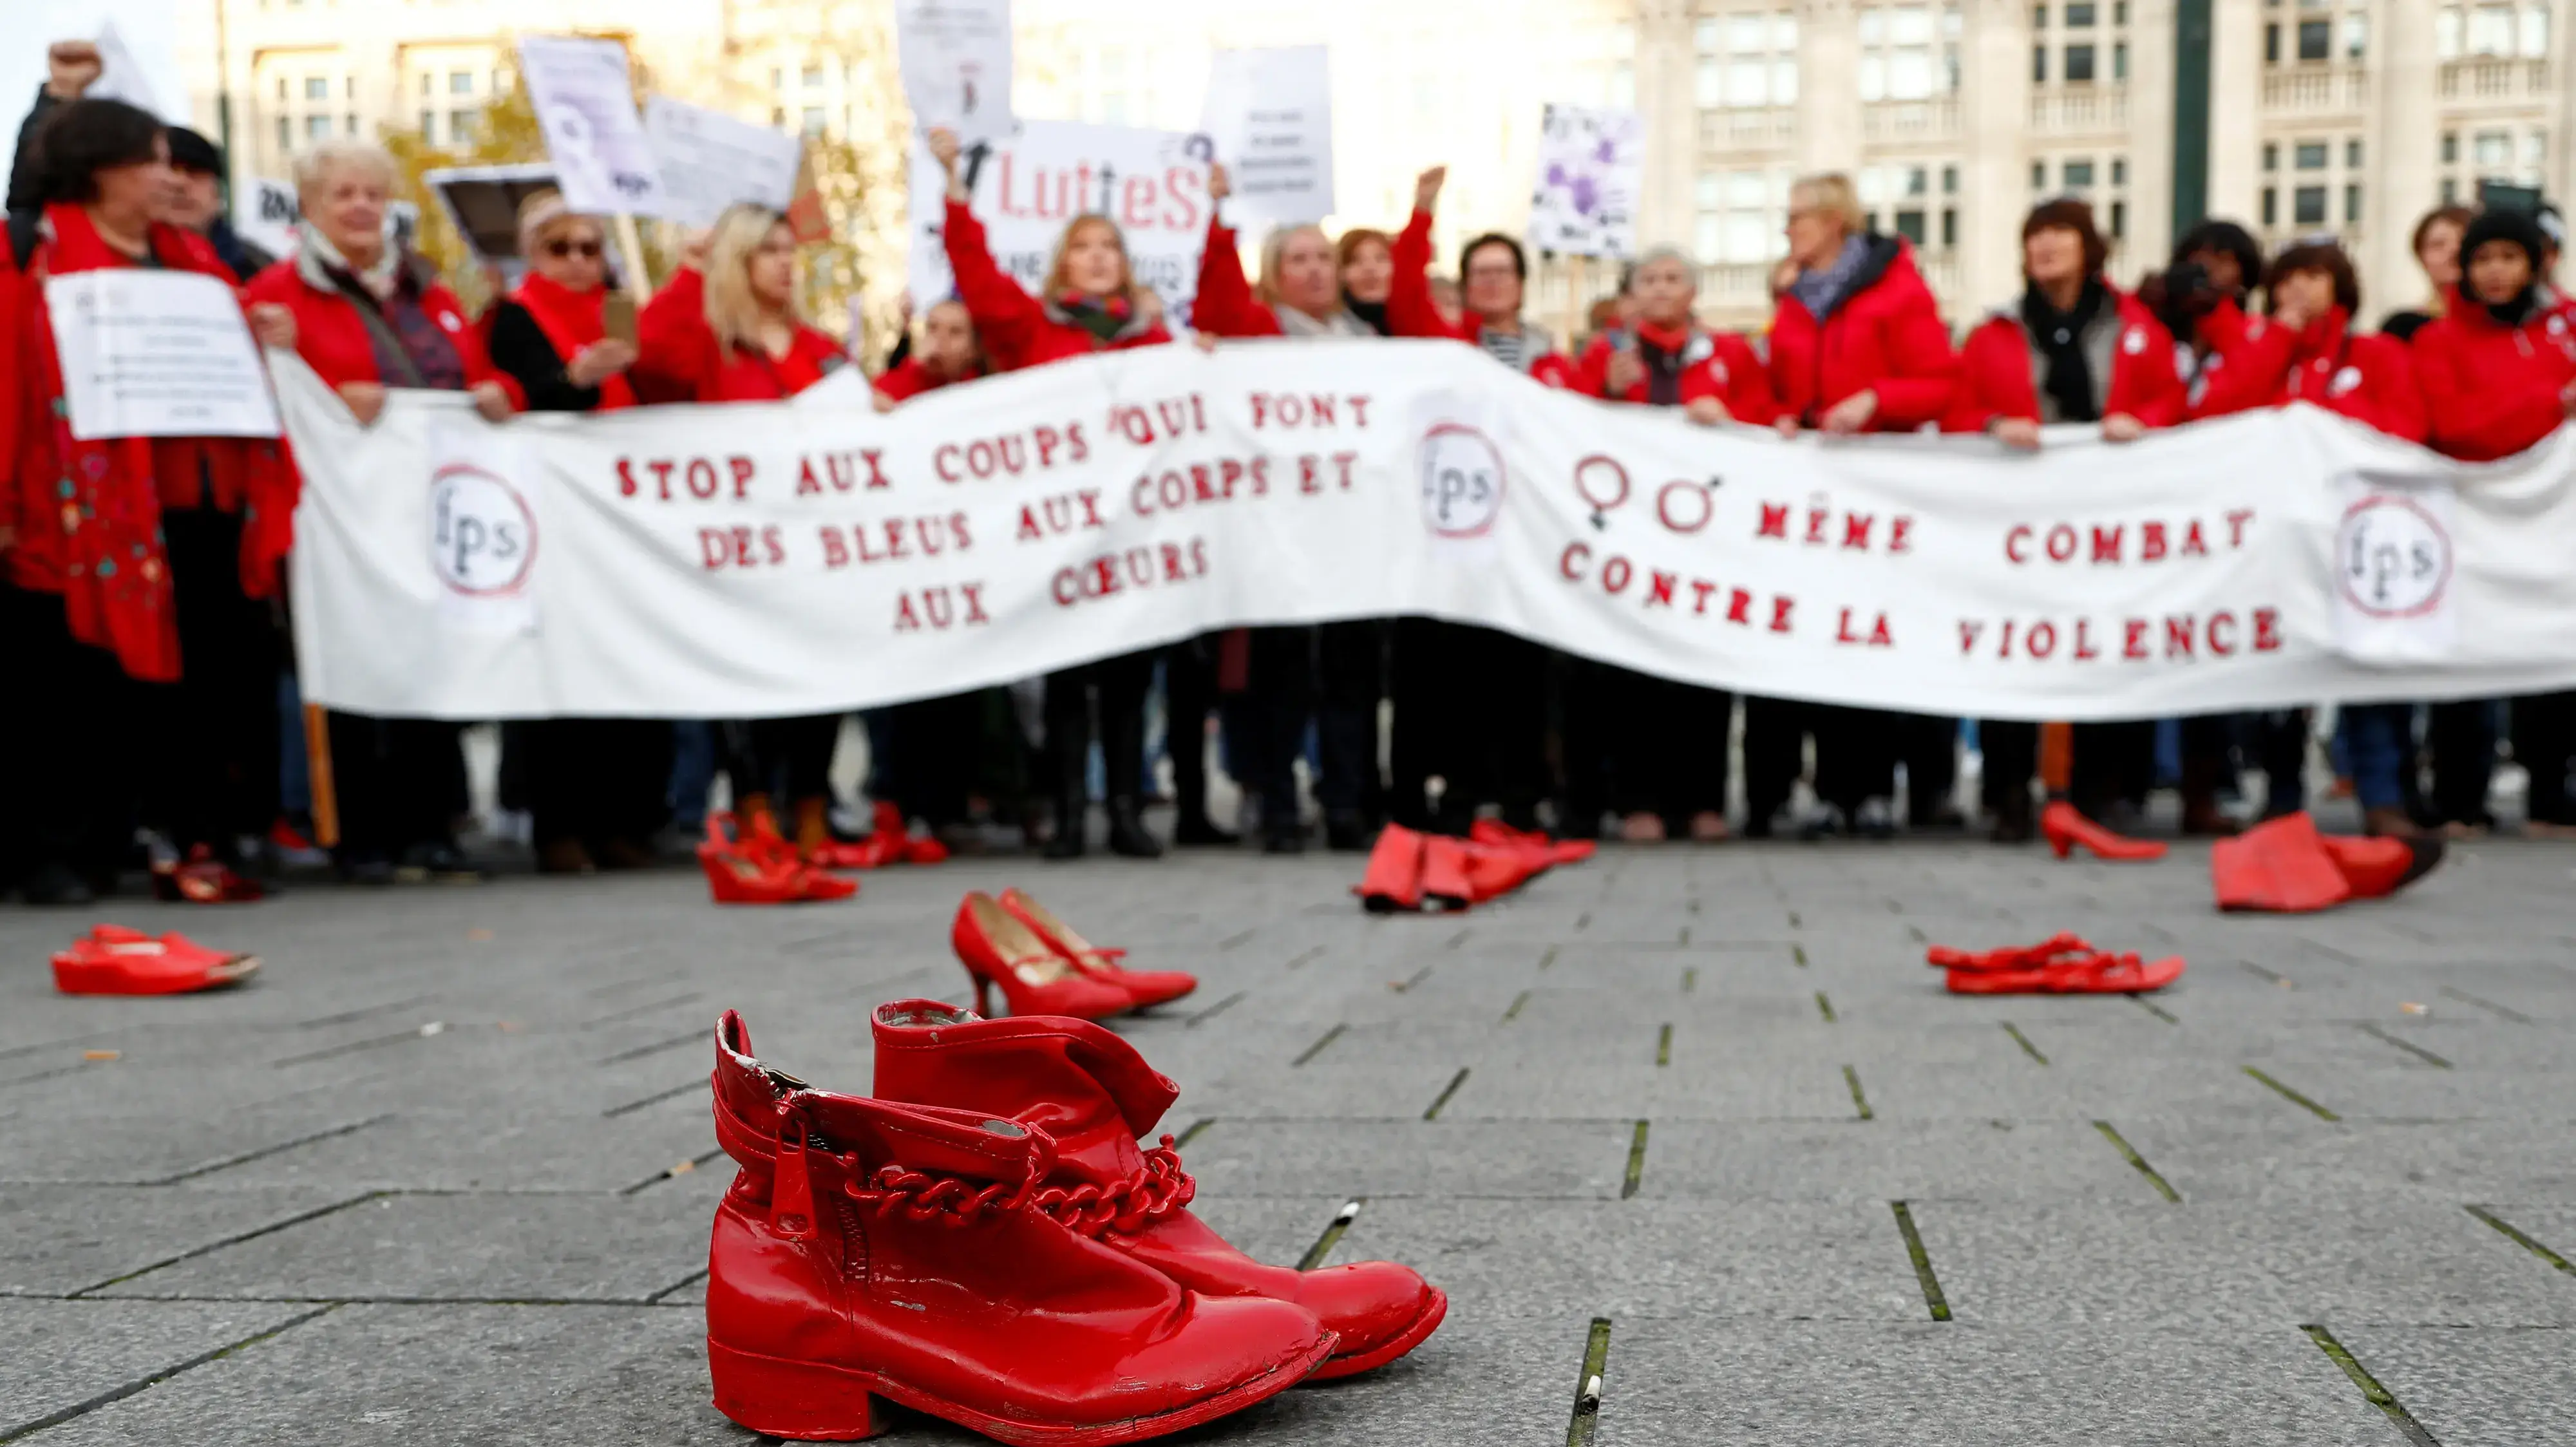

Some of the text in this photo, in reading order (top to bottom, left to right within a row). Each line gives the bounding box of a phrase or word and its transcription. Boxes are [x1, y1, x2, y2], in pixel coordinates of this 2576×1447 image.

[614, 455, 755, 502] STOP
[797, 449, 889, 494] AUX
[934, 421, 1088, 484] COUPS
[1249, 392, 1370, 429] FONT
[1420, 439, 1492, 522] fps
[433, 483, 520, 575] fps
[698, 453, 1357, 571] DES BLEUS AUX CORPS ET
[1756, 491, 2255, 565] MÊME COMBAT
[1559, 542, 2284, 661] CONTRE LA VIOLENCE
[2350, 517, 2434, 600] fps
[894, 583, 990, 629] AUX
